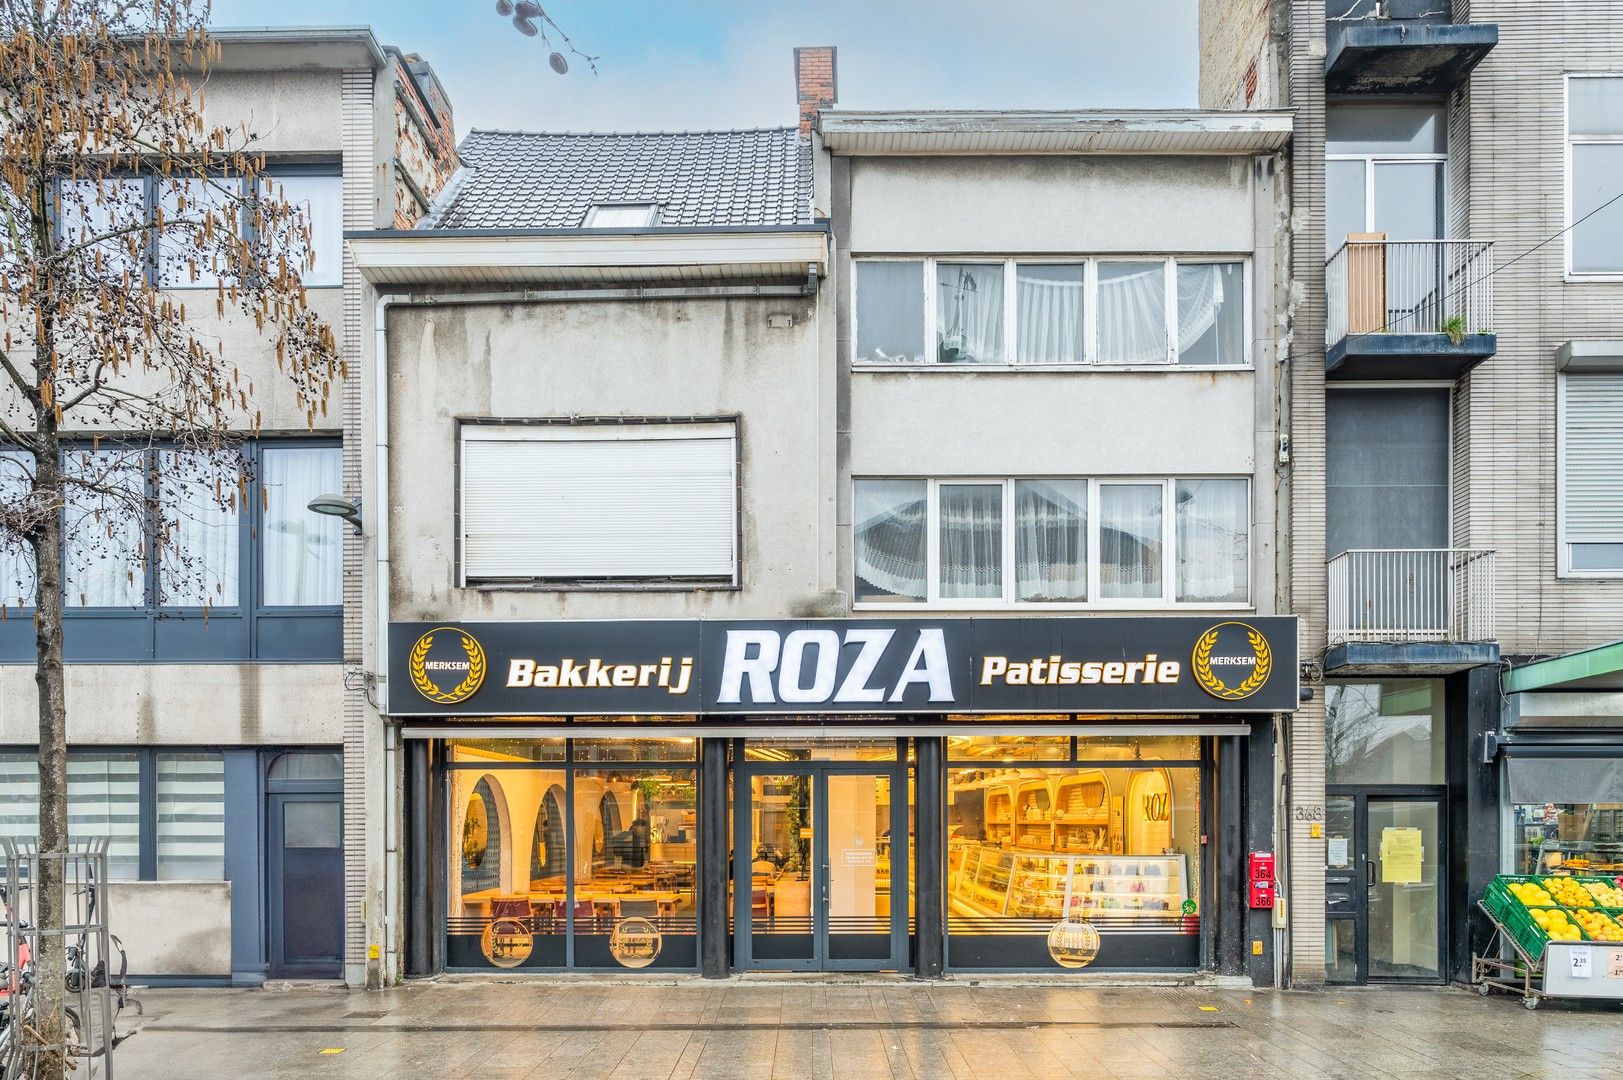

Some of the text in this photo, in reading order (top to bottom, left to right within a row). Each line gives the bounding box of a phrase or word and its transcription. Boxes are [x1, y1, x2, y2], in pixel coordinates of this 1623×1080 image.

[424, 659, 471, 672] MERKSEM
[716, 629, 954, 703] ROZA
[1208, 654, 1257, 667] MERKSEM
[505, 657, 693, 694] Bakkerij
[979, 654, 1181, 686] Patisserie
[1295, 805, 1323, 821] 368
[1255, 869, 1272, 879] 364
[1255, 896, 1272, 906] 366
